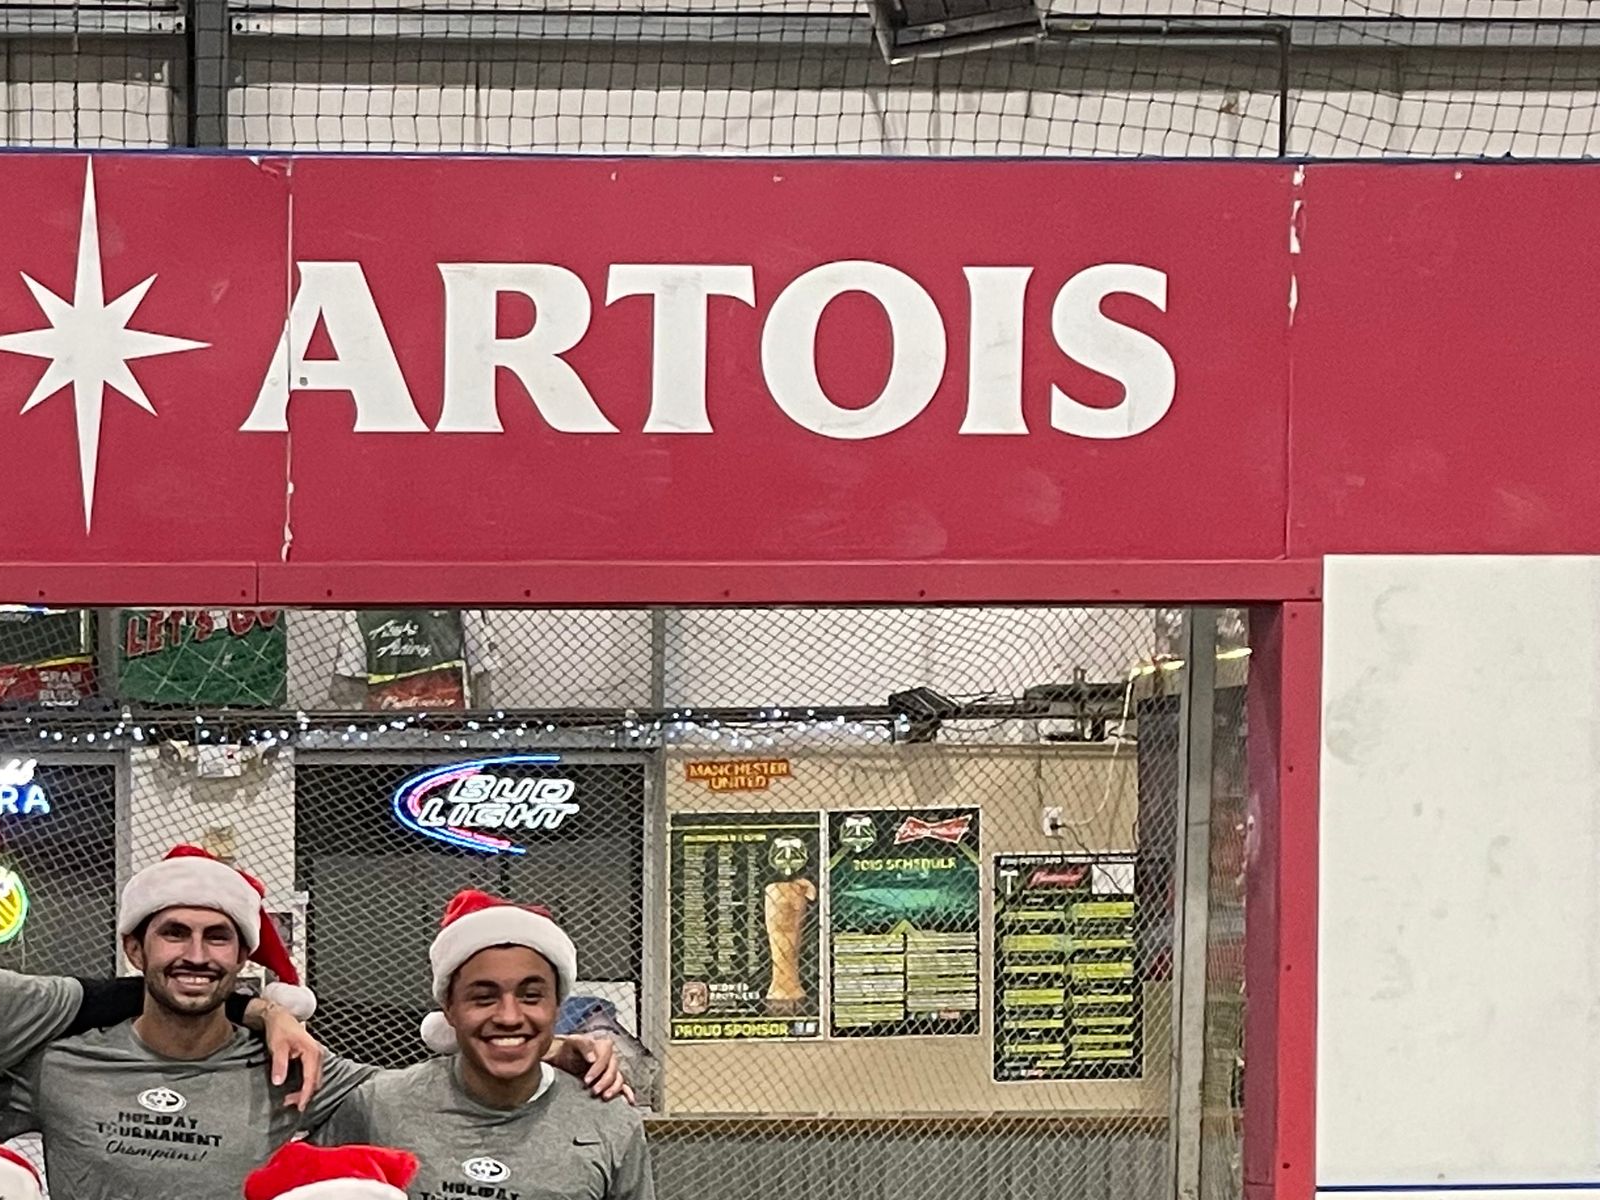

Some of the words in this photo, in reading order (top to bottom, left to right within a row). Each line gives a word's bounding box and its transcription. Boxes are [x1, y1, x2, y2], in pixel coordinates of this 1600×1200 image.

[238, 259, 1177, 440] ARTOIS
[690, 762, 788, 776] MANCHESTER
[450, 775, 576, 804] BUD
[711, 776, 766, 789] UNITED
[417, 798, 580, 829] LIGHT
[675, 1024, 721, 1037] PROUD
[724, 1022, 788, 1036] SPONSOR
[118, 1112, 199, 1130] HOLIDAY
